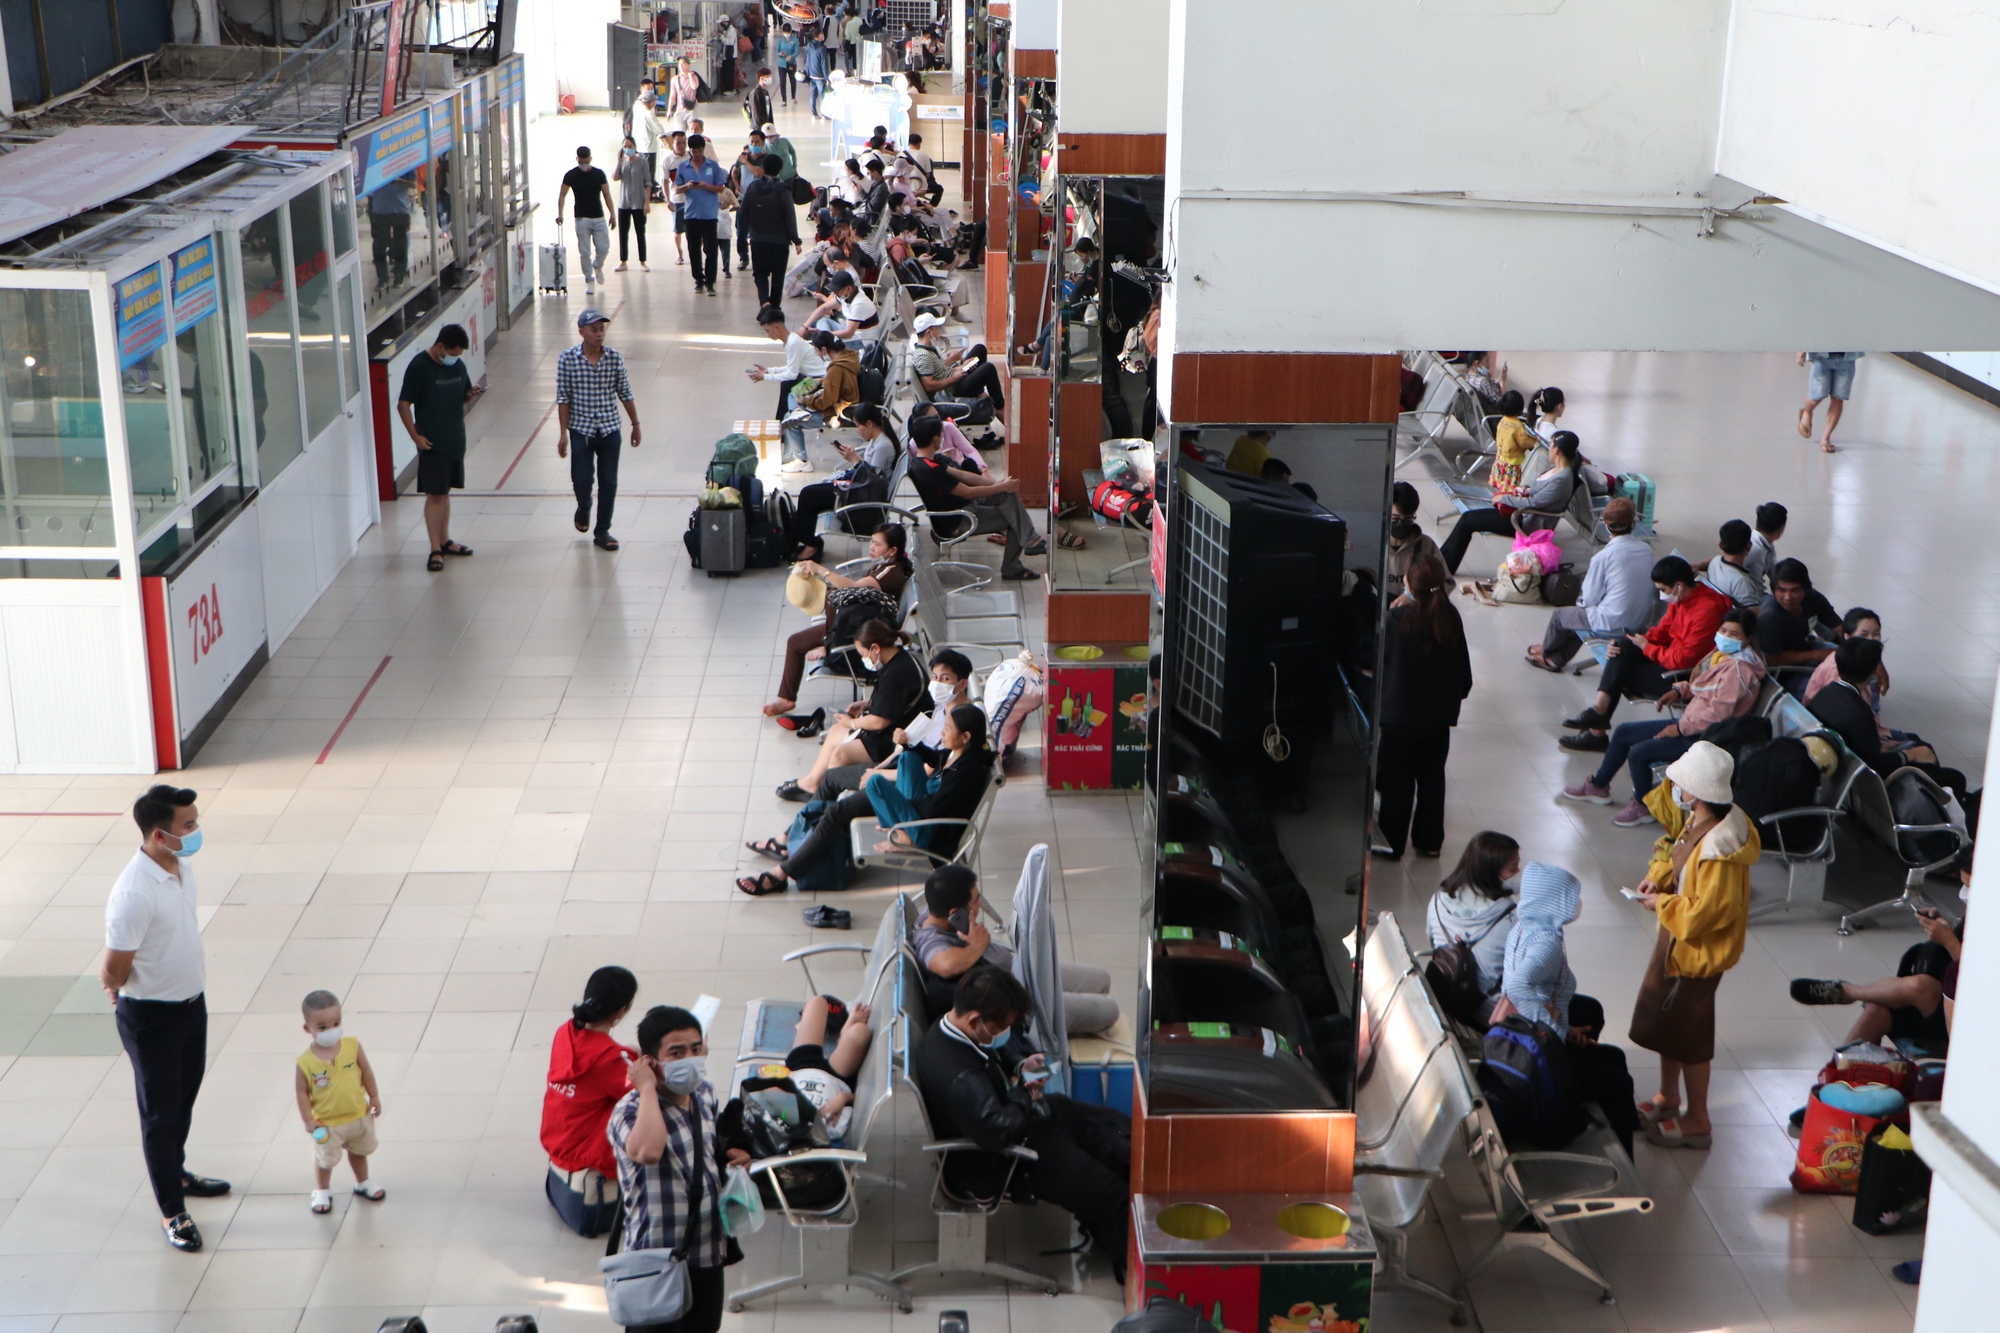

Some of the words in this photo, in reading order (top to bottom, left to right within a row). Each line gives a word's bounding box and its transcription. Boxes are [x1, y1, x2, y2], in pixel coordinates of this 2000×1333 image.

[188, 582, 224, 666] 73A
[1054, 743, 1068, 752] RÁC
[1069, 742, 1085, 752] THẢI
[1085, 742, 1104, 752] CỨNG
[1116, 743, 1131, 752] RÁC
